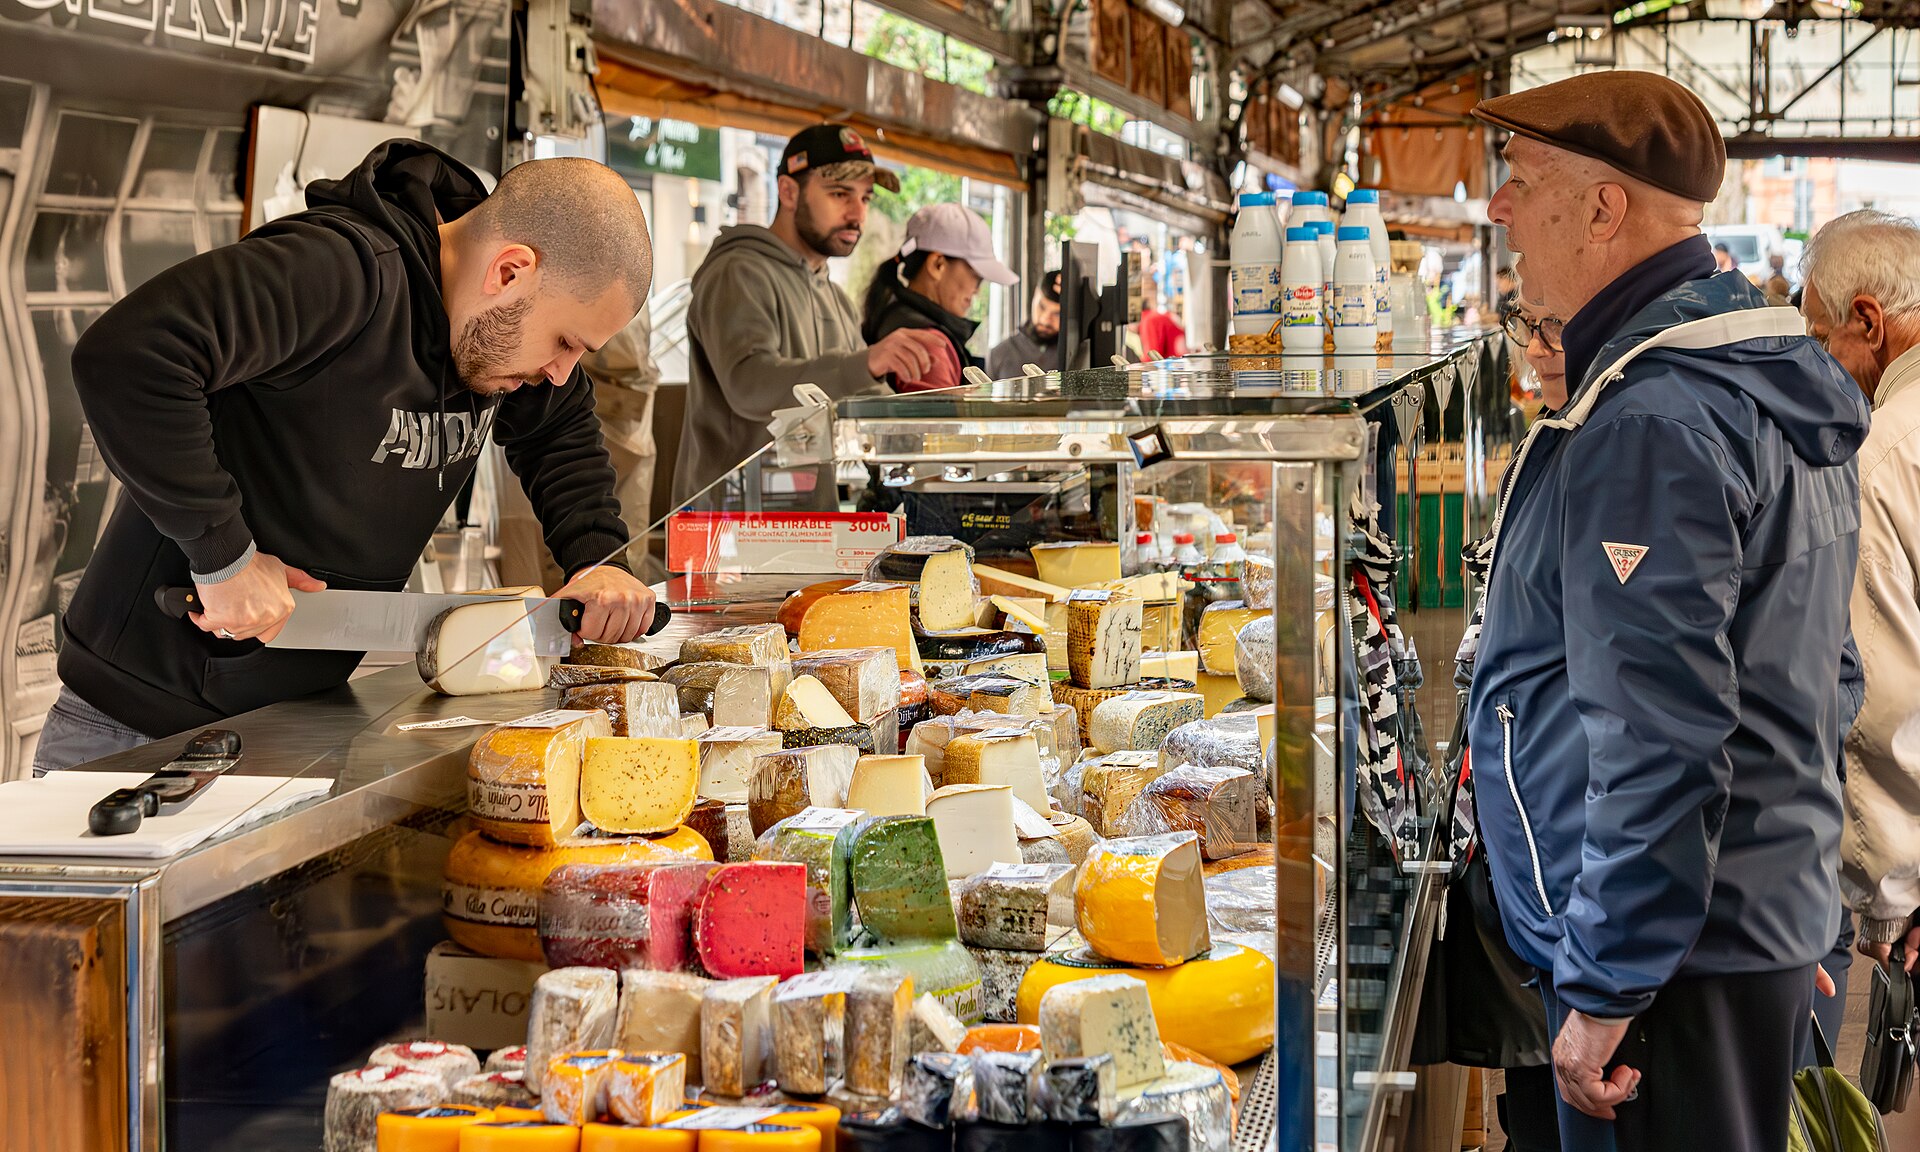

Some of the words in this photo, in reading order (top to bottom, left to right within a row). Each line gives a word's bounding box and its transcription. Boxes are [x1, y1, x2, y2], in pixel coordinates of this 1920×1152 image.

[738, 520, 768, 529] FILM
[771, 520, 833, 529] ETIRABLE
[848, 520, 891, 533] 300M
[1613, 548, 1638, 557] GUESS
